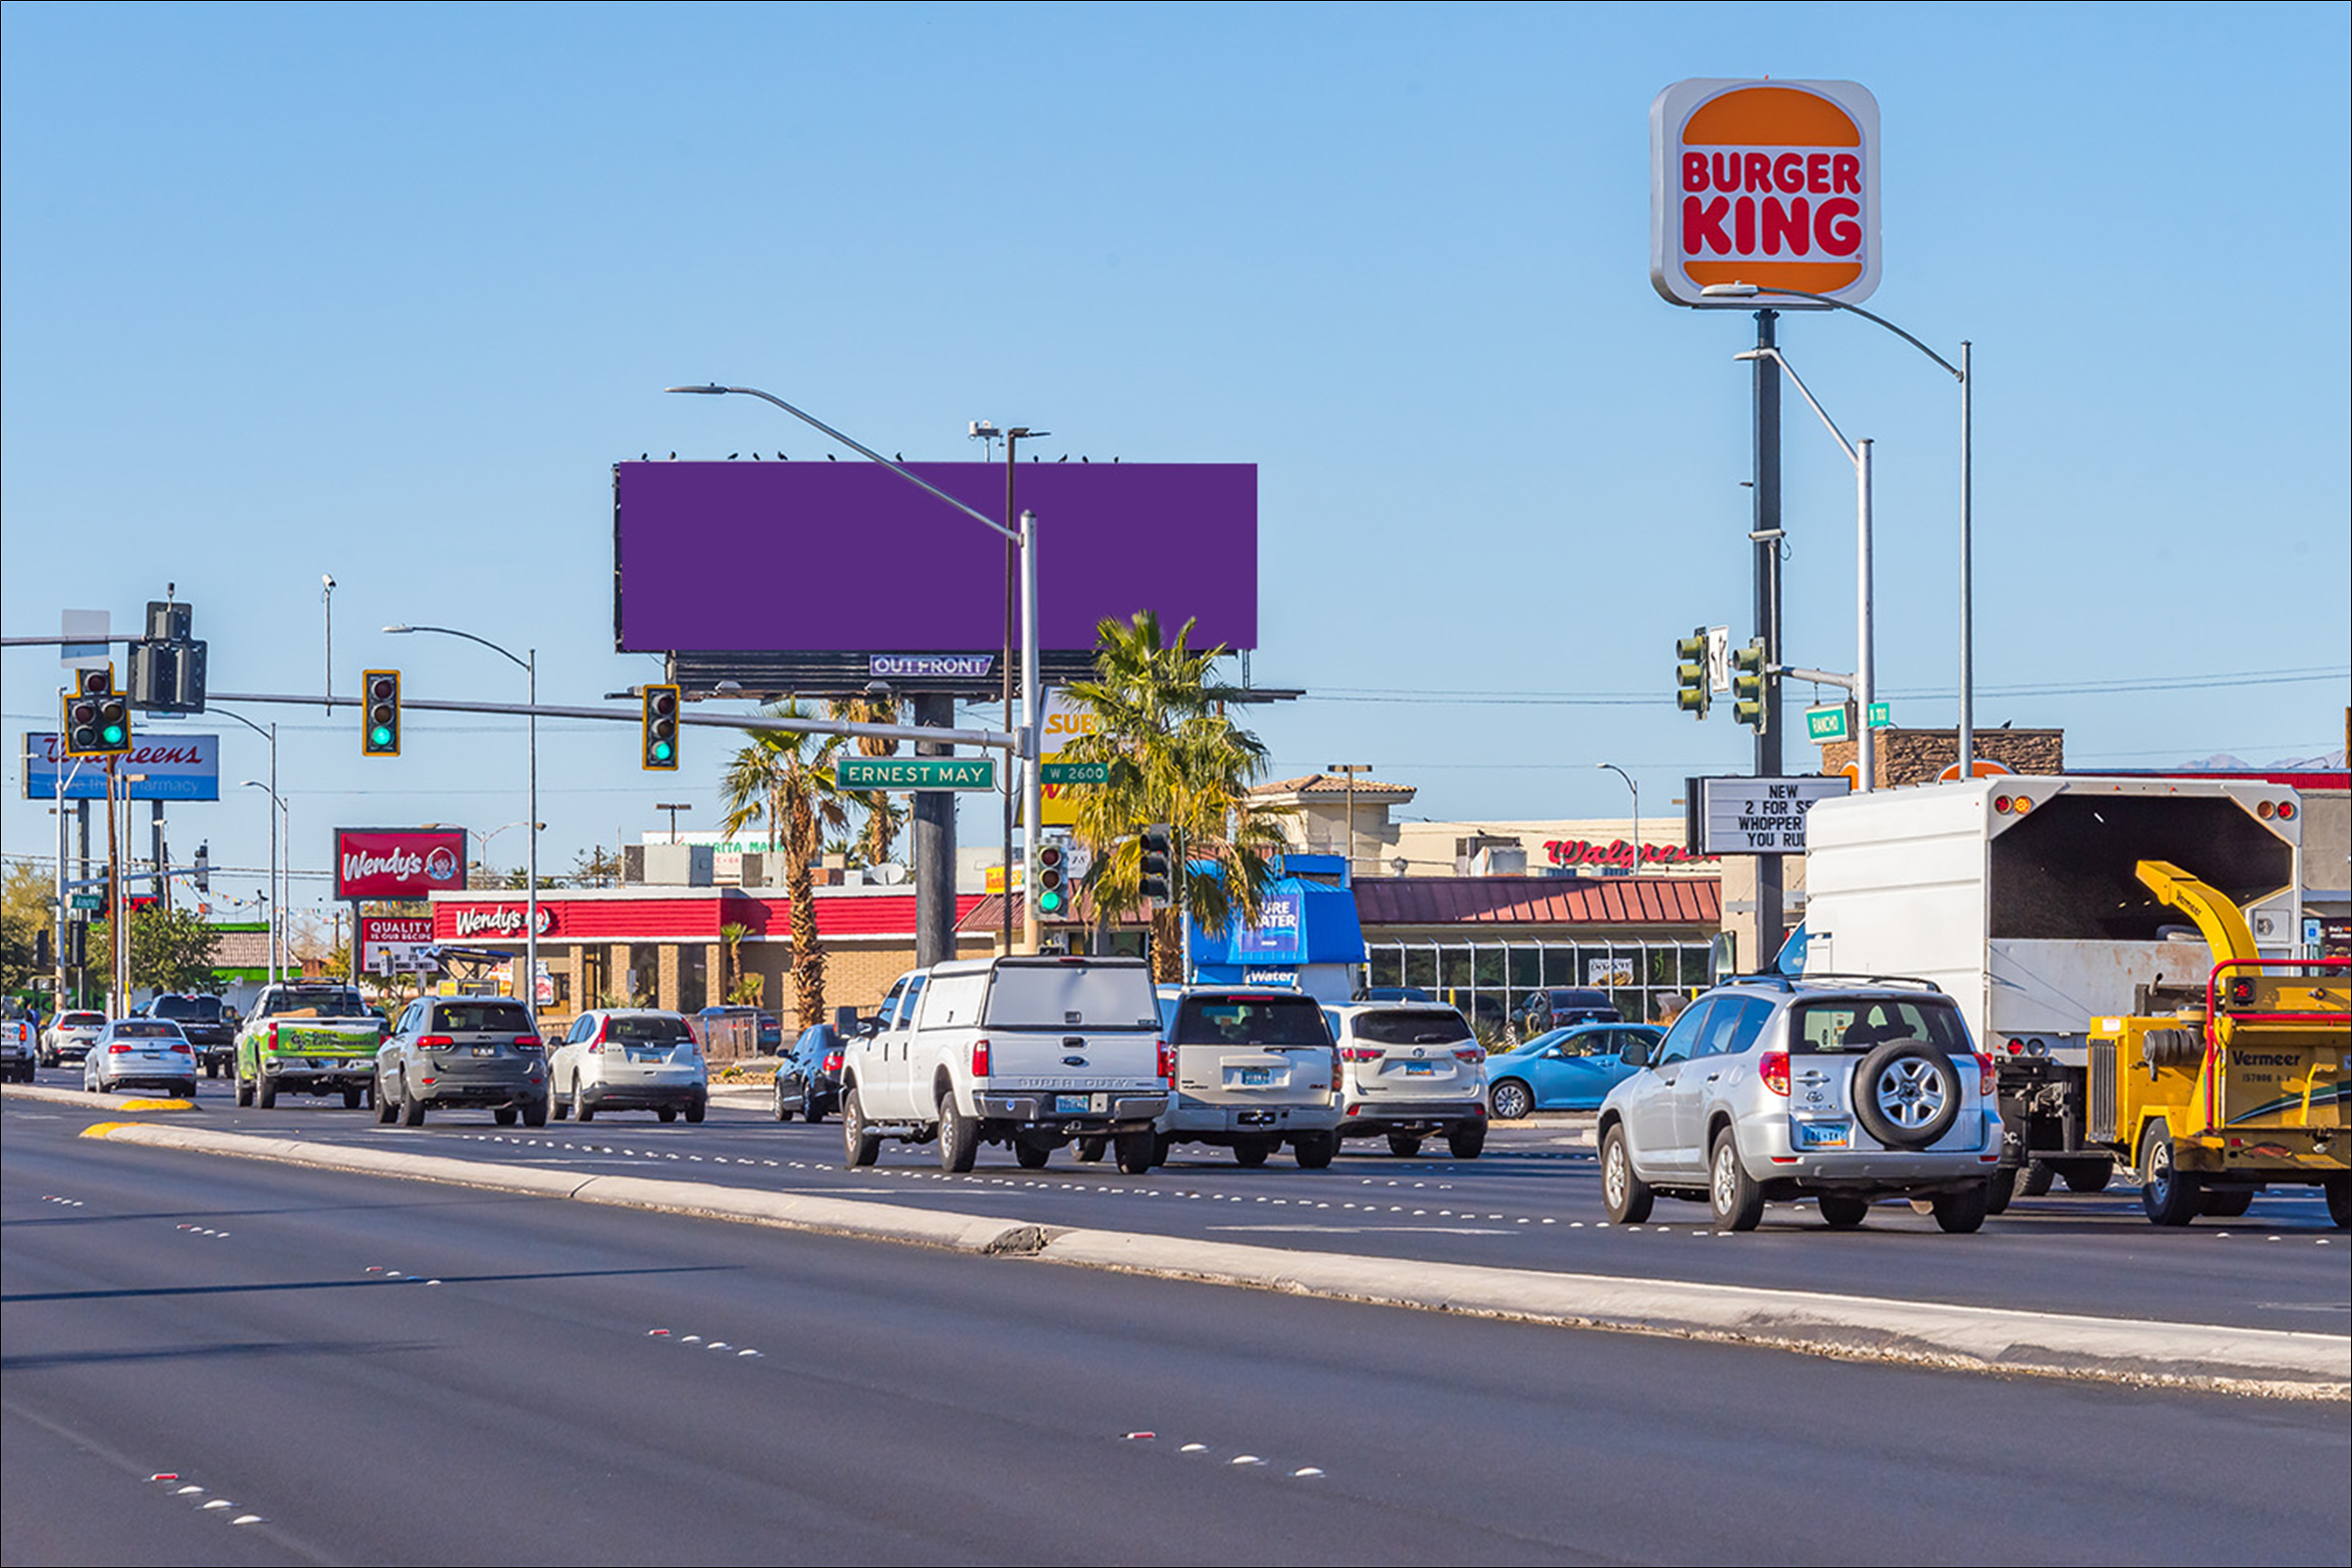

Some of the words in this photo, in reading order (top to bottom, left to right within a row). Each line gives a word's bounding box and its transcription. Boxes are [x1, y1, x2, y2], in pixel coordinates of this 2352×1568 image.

[1683, 152, 1861, 194] BURGER
[1683, 196, 1862, 256] KING
[874, 658, 986, 674] OUTFRONT
[1044, 713, 1097, 735] SUB
[849, 767, 931, 782] ERNEST
[939, 767, 984, 782] MAY
[1051, 768, 1060, 779] W
[1068, 767, 1104, 780] 2600
[1769, 785, 1797, 799] NEW
[1745, 801, 1753, 814] 2
[1762, 801, 1788, 814] FOR
[1739, 816, 1801, 830] WHOPPER
[1747, 833, 1774, 847] YOU
[1784, 833, 1806, 847] RUL
[343, 847, 422, 881] Wendy's
[1259, 902, 1290, 914] URE
[370, 922, 431, 933] QUALITY
[457, 906, 521, 936] Wendy's
[1251, 970, 1294, 982] Water
[2232, 1051, 2300, 1065] Vermeer
[1019, 1079, 1075, 1088] SUPER
[1086, 1079, 1128, 1088] DUTY
